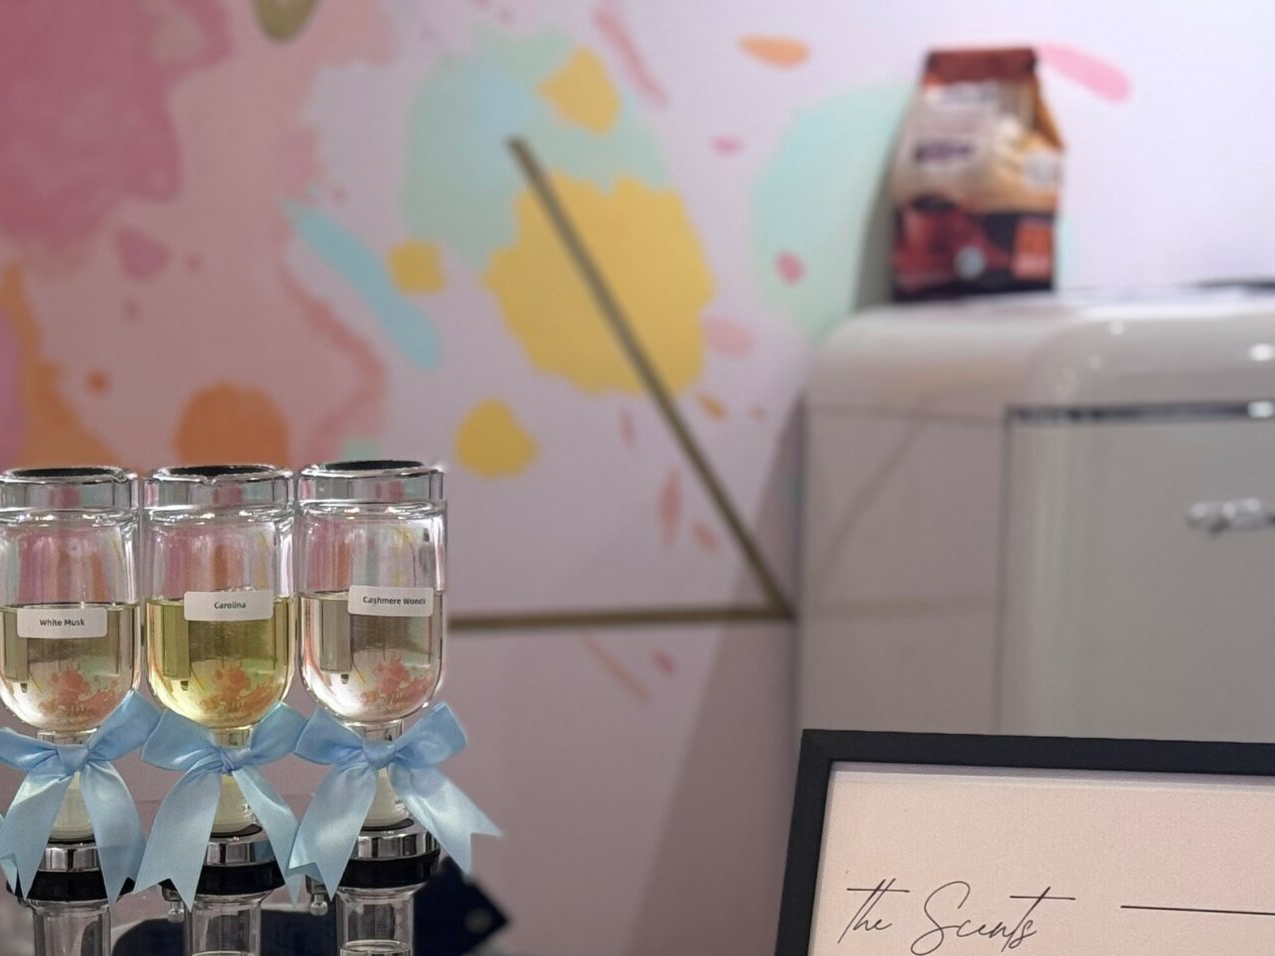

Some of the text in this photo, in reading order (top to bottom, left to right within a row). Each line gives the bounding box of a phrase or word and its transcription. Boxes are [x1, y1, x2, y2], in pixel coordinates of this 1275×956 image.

[363, 596, 402, 605] Cashmere
[213, 601, 247, 609] Carolina
[39, 619, 63, 627] White
[837, 878, 1076, 956] the Scents
